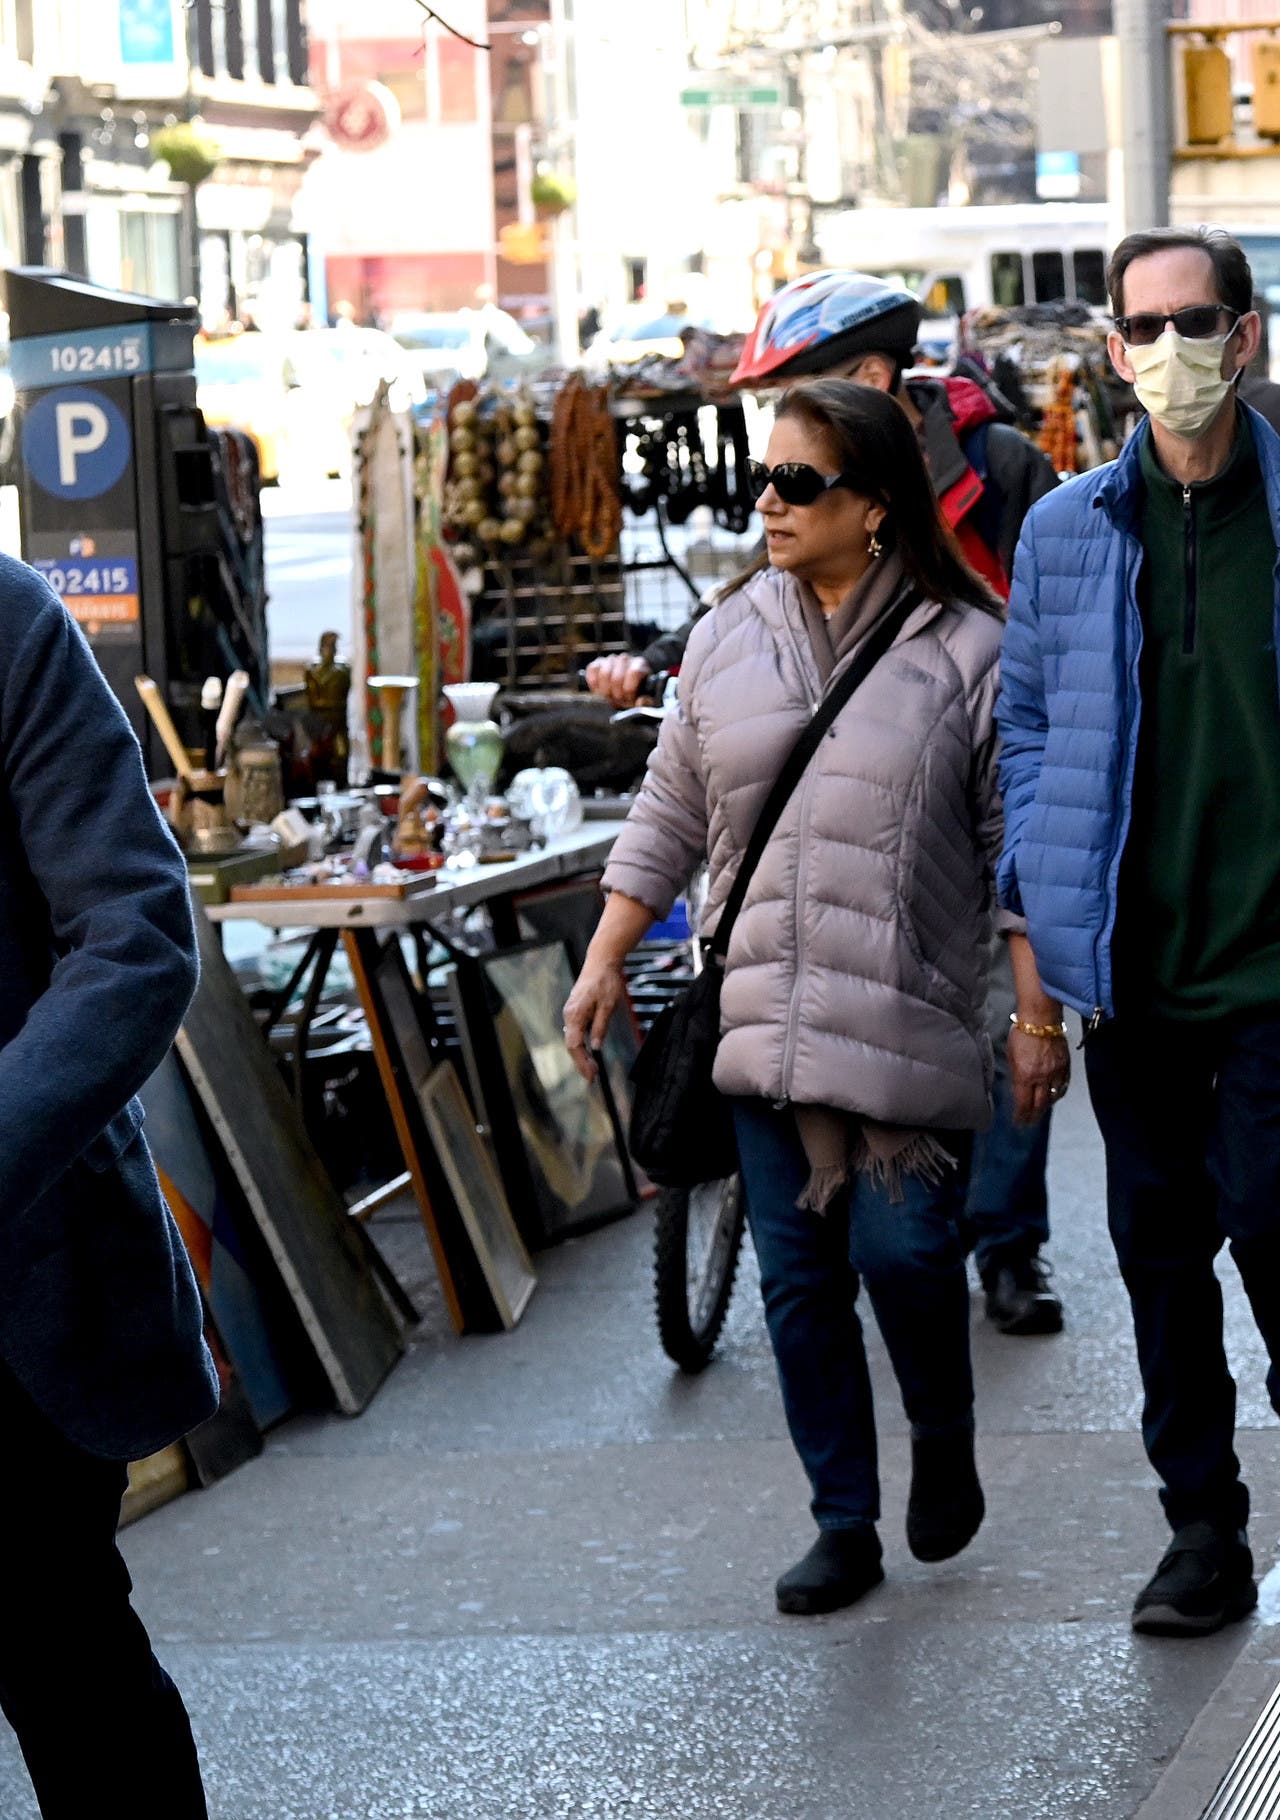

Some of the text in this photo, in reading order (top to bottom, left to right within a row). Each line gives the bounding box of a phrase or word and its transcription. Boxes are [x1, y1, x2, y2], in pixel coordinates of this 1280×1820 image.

[51, 345, 141, 372] 102415
[56, 402, 109, 486] P
[42, 567, 129, 594] 02415
